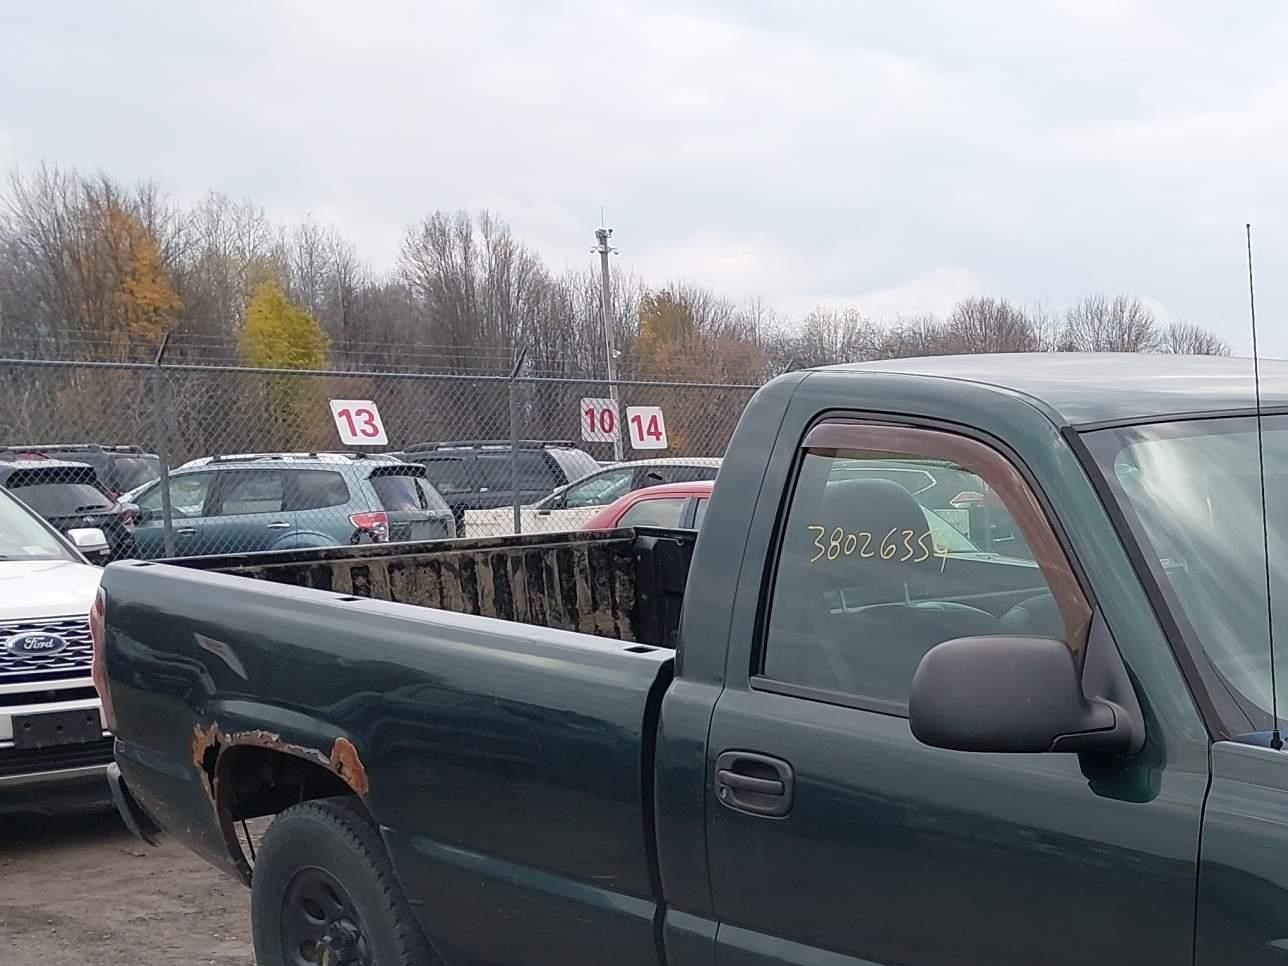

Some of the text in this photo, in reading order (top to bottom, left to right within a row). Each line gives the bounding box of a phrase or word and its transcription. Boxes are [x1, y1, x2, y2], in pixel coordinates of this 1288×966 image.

[337, 408, 381, 438] 13
[584, 407, 616, 434] 10
[631, 414, 663, 442] 14
[808, 525, 950, 573] 38026354
[23, 636, 55, 650] Ford
